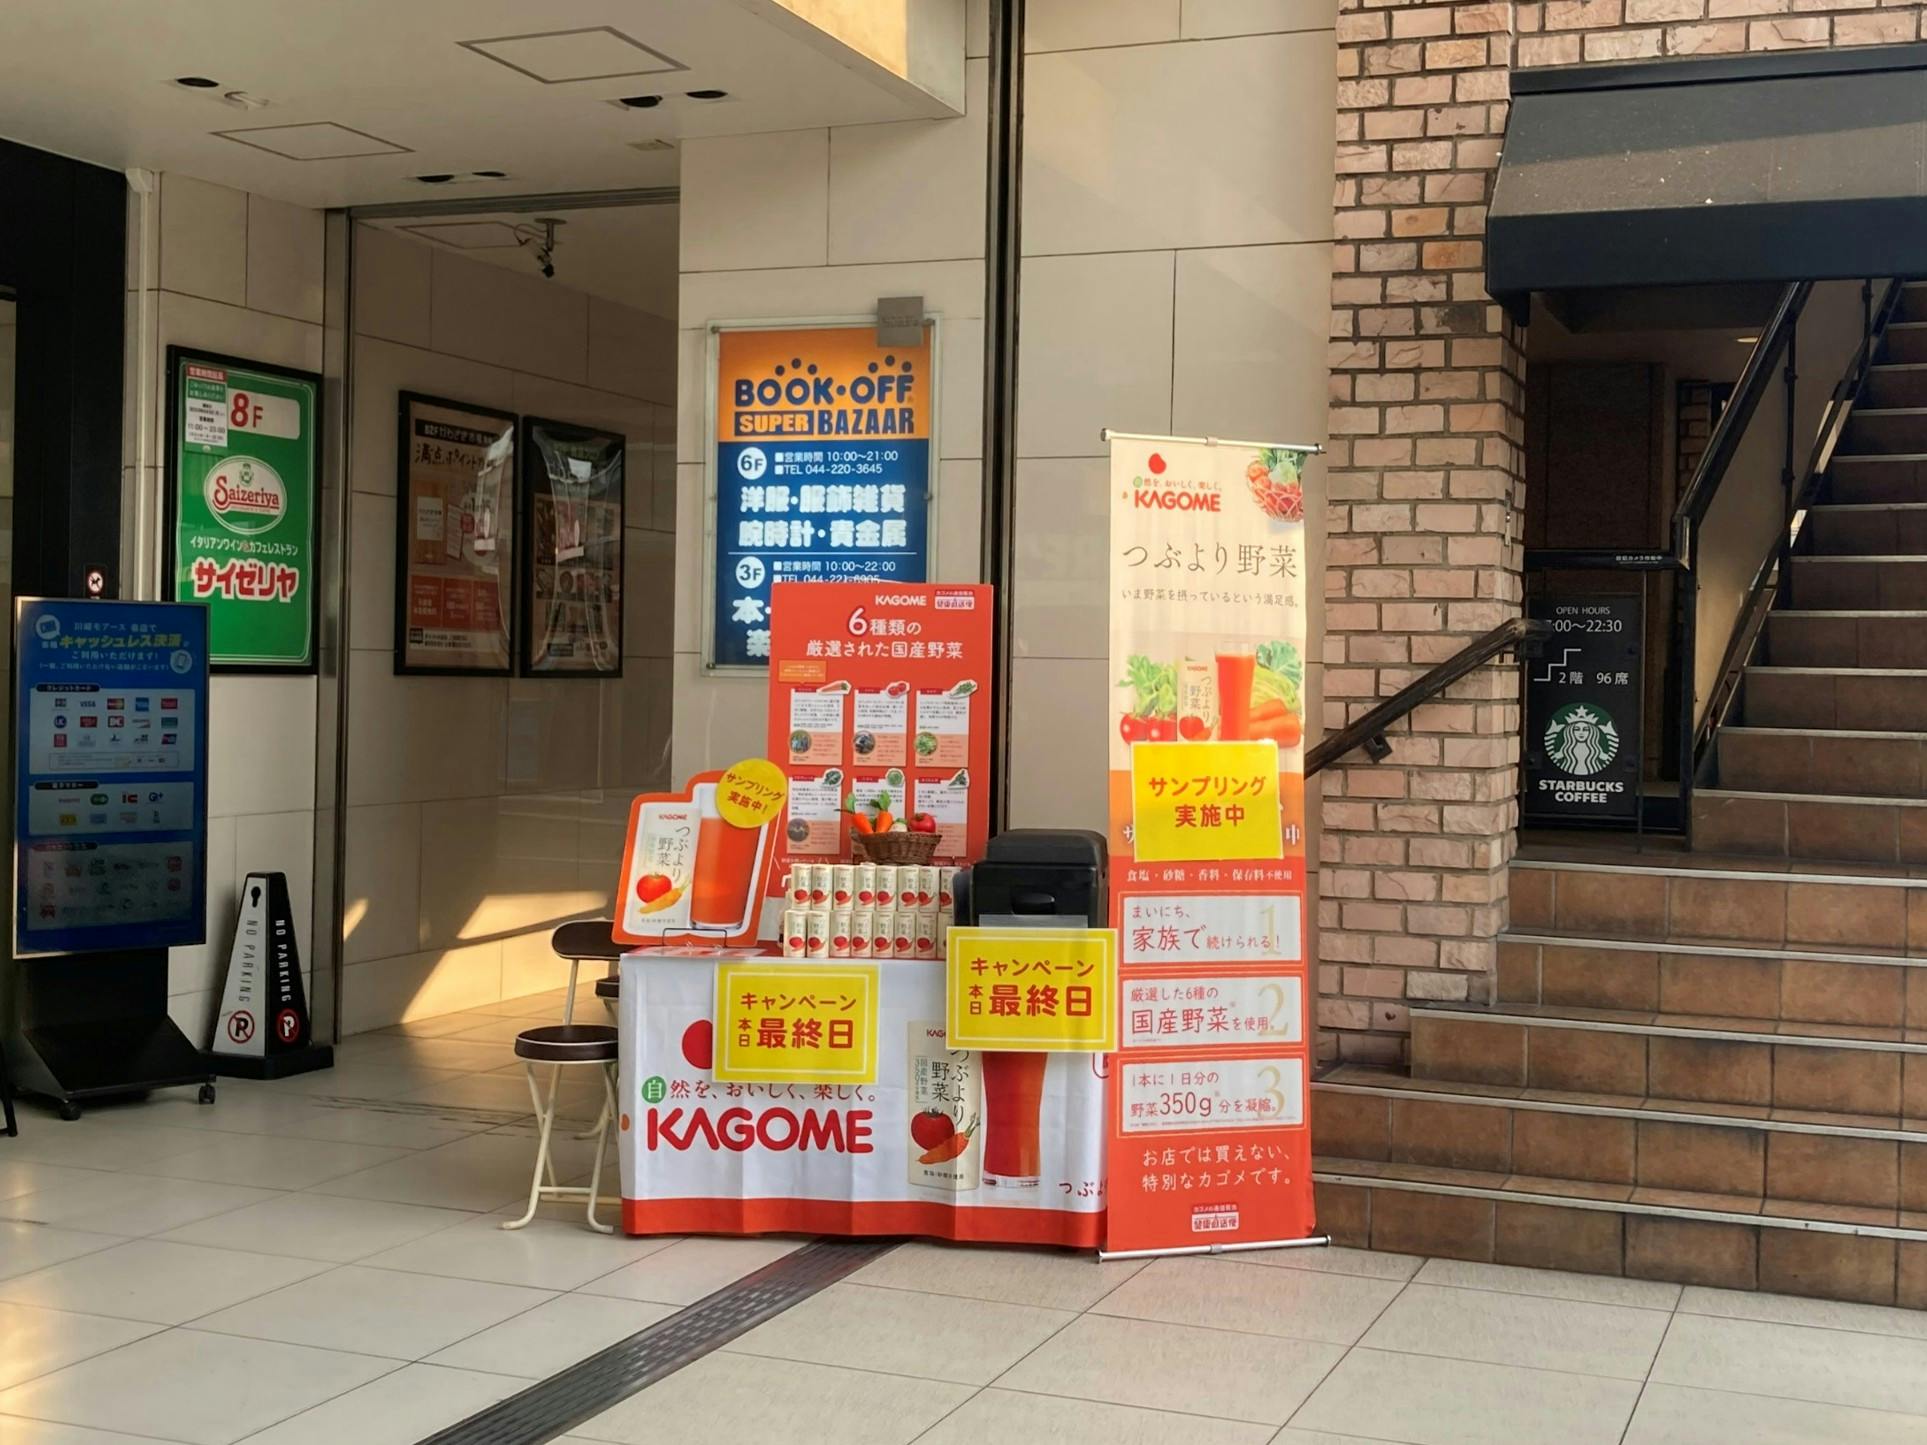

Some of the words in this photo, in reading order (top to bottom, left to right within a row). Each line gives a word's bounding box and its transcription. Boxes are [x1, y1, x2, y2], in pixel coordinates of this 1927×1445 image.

[739, 414, 809, 433] SUPER
[818, 408, 914, 434] BAZAAR
[741, 455, 764, 472] 6F
[784, 465, 803, 475] TEL
[805, 463, 883, 475] 044-220-3645
[213, 475, 280, 508] Saizeriya
[1134, 489, 1221, 512] KAGOME
[738, 519, 907, 547] 腕時計・貴金属
[1122, 542, 1297, 578] つぶより野菜
[193, 557, 298, 601] サイゼリヤ
[739, 564, 763, 581] 3F
[875, 594, 927, 606] KAGOME
[1555, 606, 1579, 615] OPEN
[1582, 606, 1611, 615] HOURS
[849, 607, 922, 637] 6種類の
[1546, 619, 1622, 633] :00～22:30
[806, 640, 963, 659] 厳選された国産野菜
[726, 772, 785, 802] サンプリング
[1148, 775, 1267, 797] サンプリング
[1538, 779, 1624, 793] STARBUCKS
[1555, 791, 1607, 803] COFFEE
[1175, 804, 1245, 828] 実施中
[657, 836, 674, 866] 野菜
[673, 825, 691, 883] つぶより
[1131, 905, 1190, 919] まいにち、
[245, 919, 258, 936] NO
[275, 919, 286, 936] NO
[238, 944, 257, 1003] PARKING
[277, 943, 292, 1002] PARKING
[970, 957, 1095, 977] キャンペーン
[740, 993, 857, 1011] キャンペーン
[968, 984, 983, 1016] 本日
[989, 984, 1092, 1016] 最終日
[1131, 986, 1219, 1001] 厳選した6種の
[738, 1018, 752, 1048] 本日
[757, 1018, 853, 1049] 最終日
[926, 1028, 946, 1038] KAG
[642, 1077, 876, 1102] 自然を、おいしく、楽しく。
[931, 1061, 951, 1103] 野菜
[647, 1107, 874, 1154] KAGOME
[1142, 1143, 1291, 1167] お店では買えない、
[1141, 1168, 1291, 1193] 特別なカゴメです。
